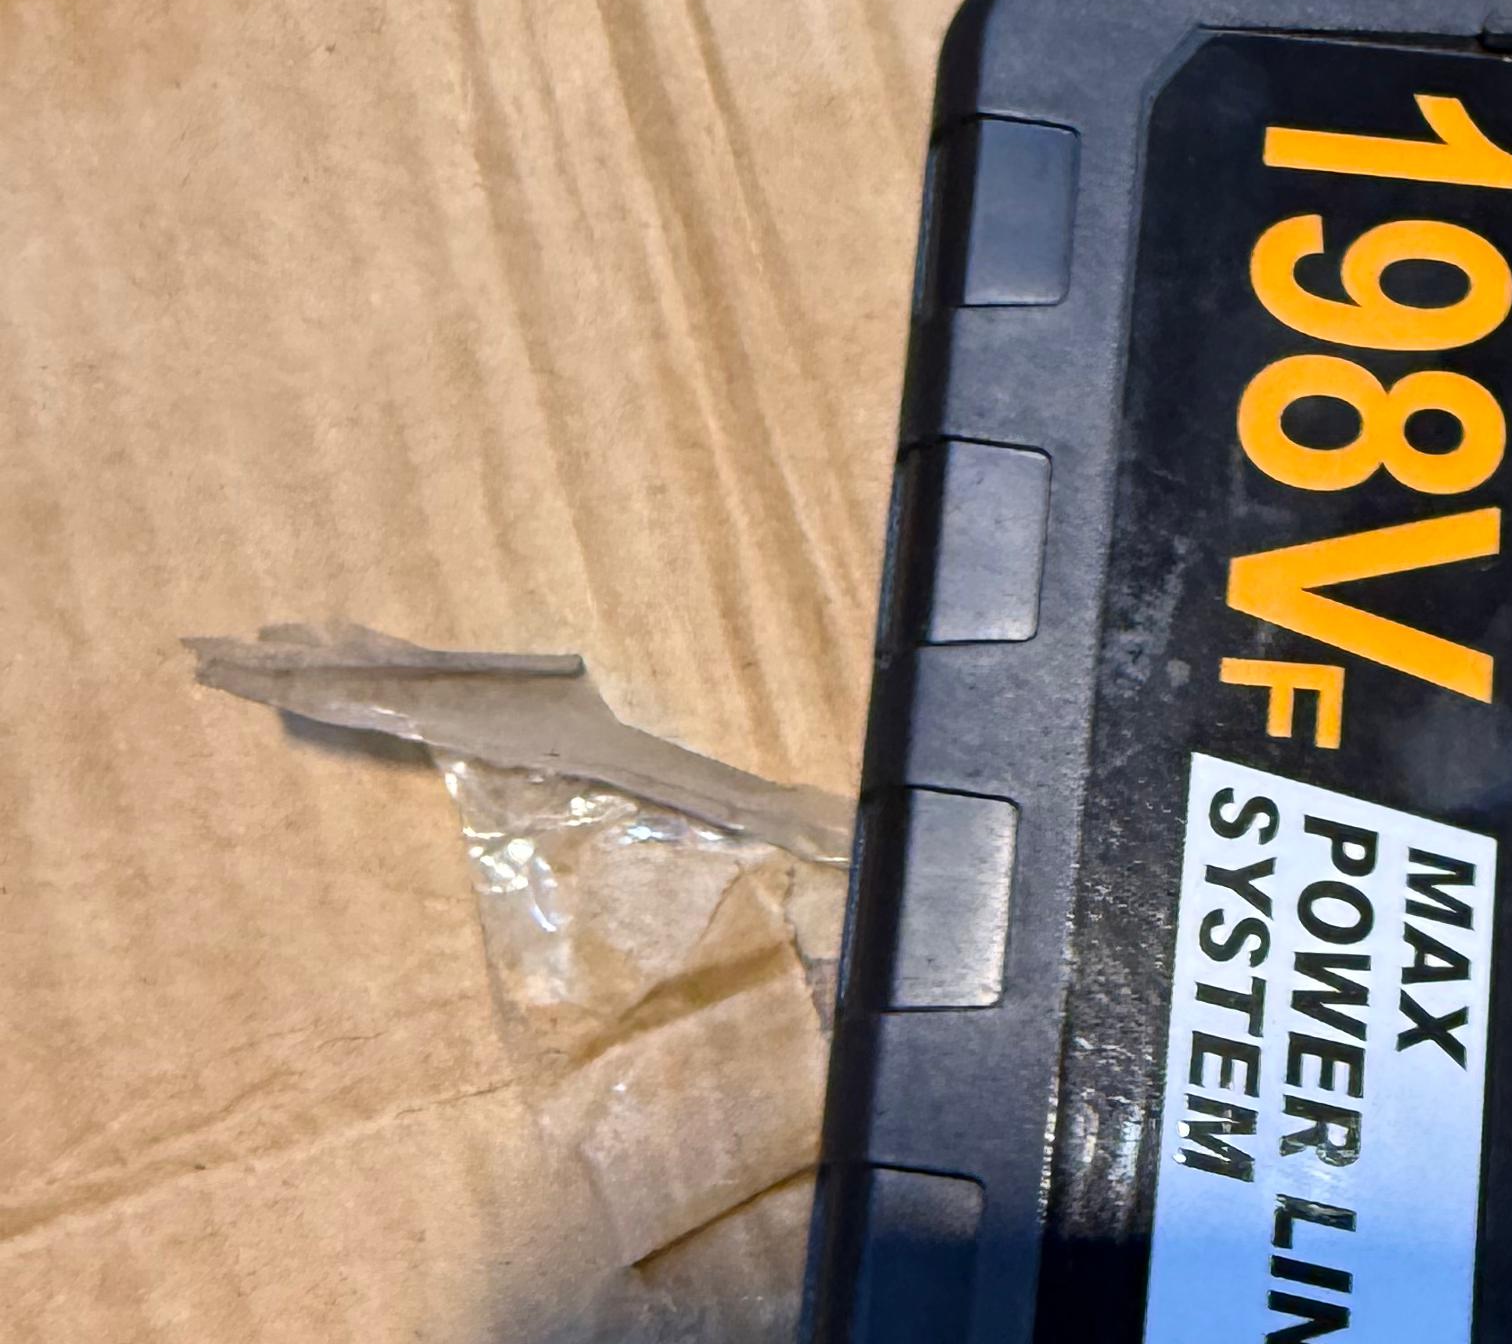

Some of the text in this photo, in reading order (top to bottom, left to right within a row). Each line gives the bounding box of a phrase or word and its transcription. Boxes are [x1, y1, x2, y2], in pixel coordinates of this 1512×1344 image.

[1174, 786, 1279, 1184] SYSTEM
[1277, 813, 1378, 1168] POWER
[1394, 846, 1476, 1070] MAX
